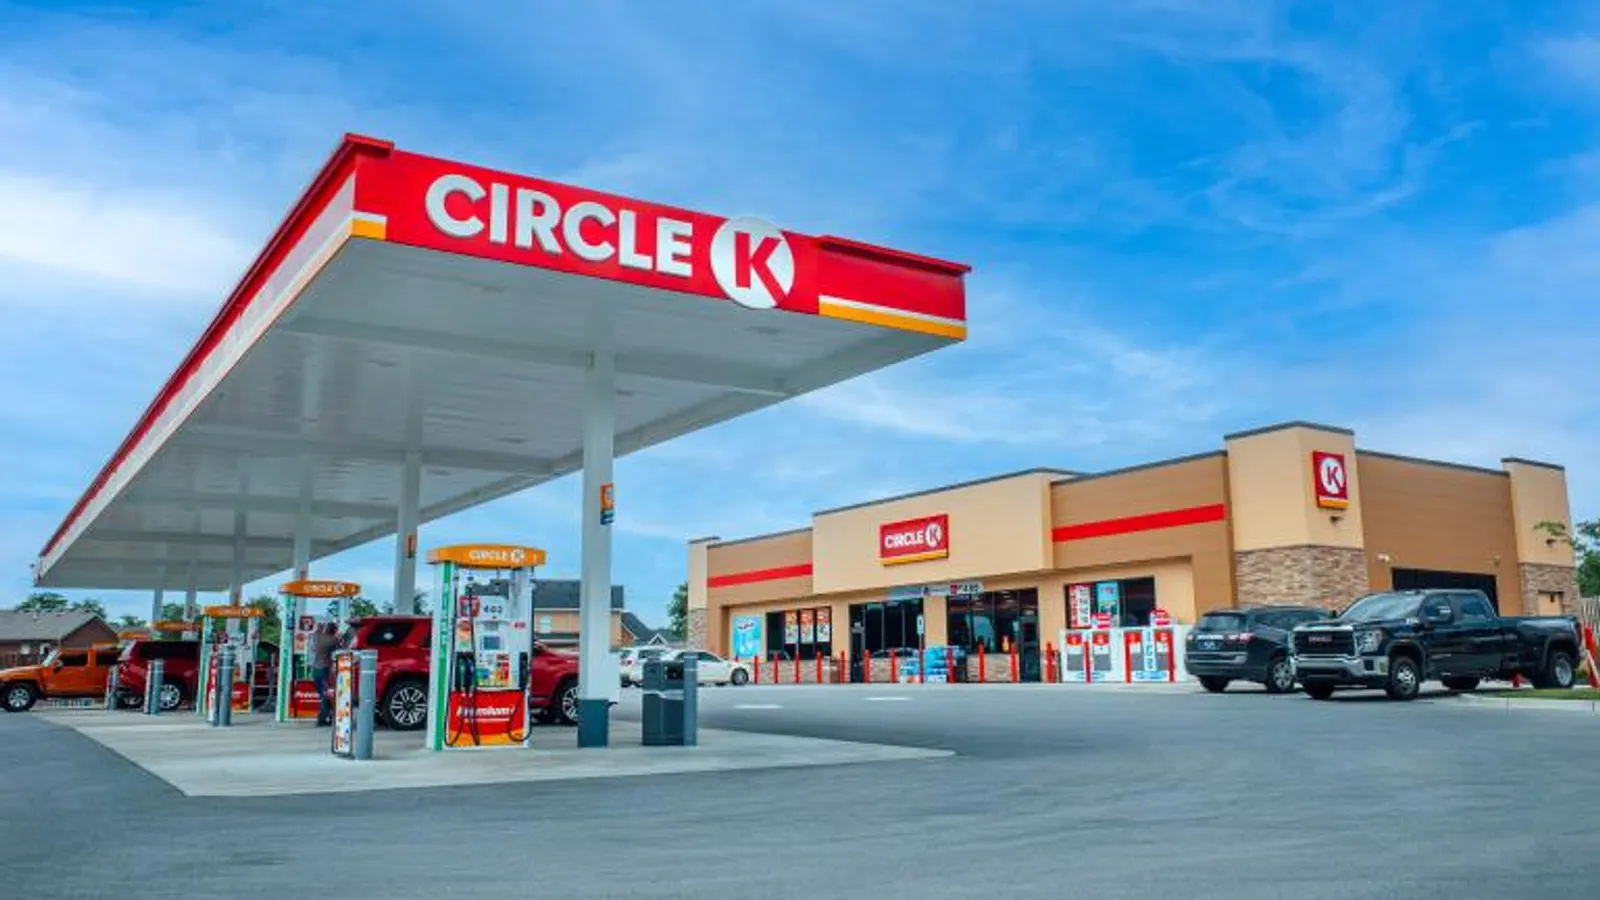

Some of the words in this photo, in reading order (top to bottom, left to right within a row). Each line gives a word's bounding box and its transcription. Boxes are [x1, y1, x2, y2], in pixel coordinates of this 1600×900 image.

[425, 173, 693, 278] CIRCLE
[722, 222, 792, 309] K
[1323, 461, 1343, 493] K
[884, 529, 924, 549] CIRCLE
[927, 523, 942, 548] K
